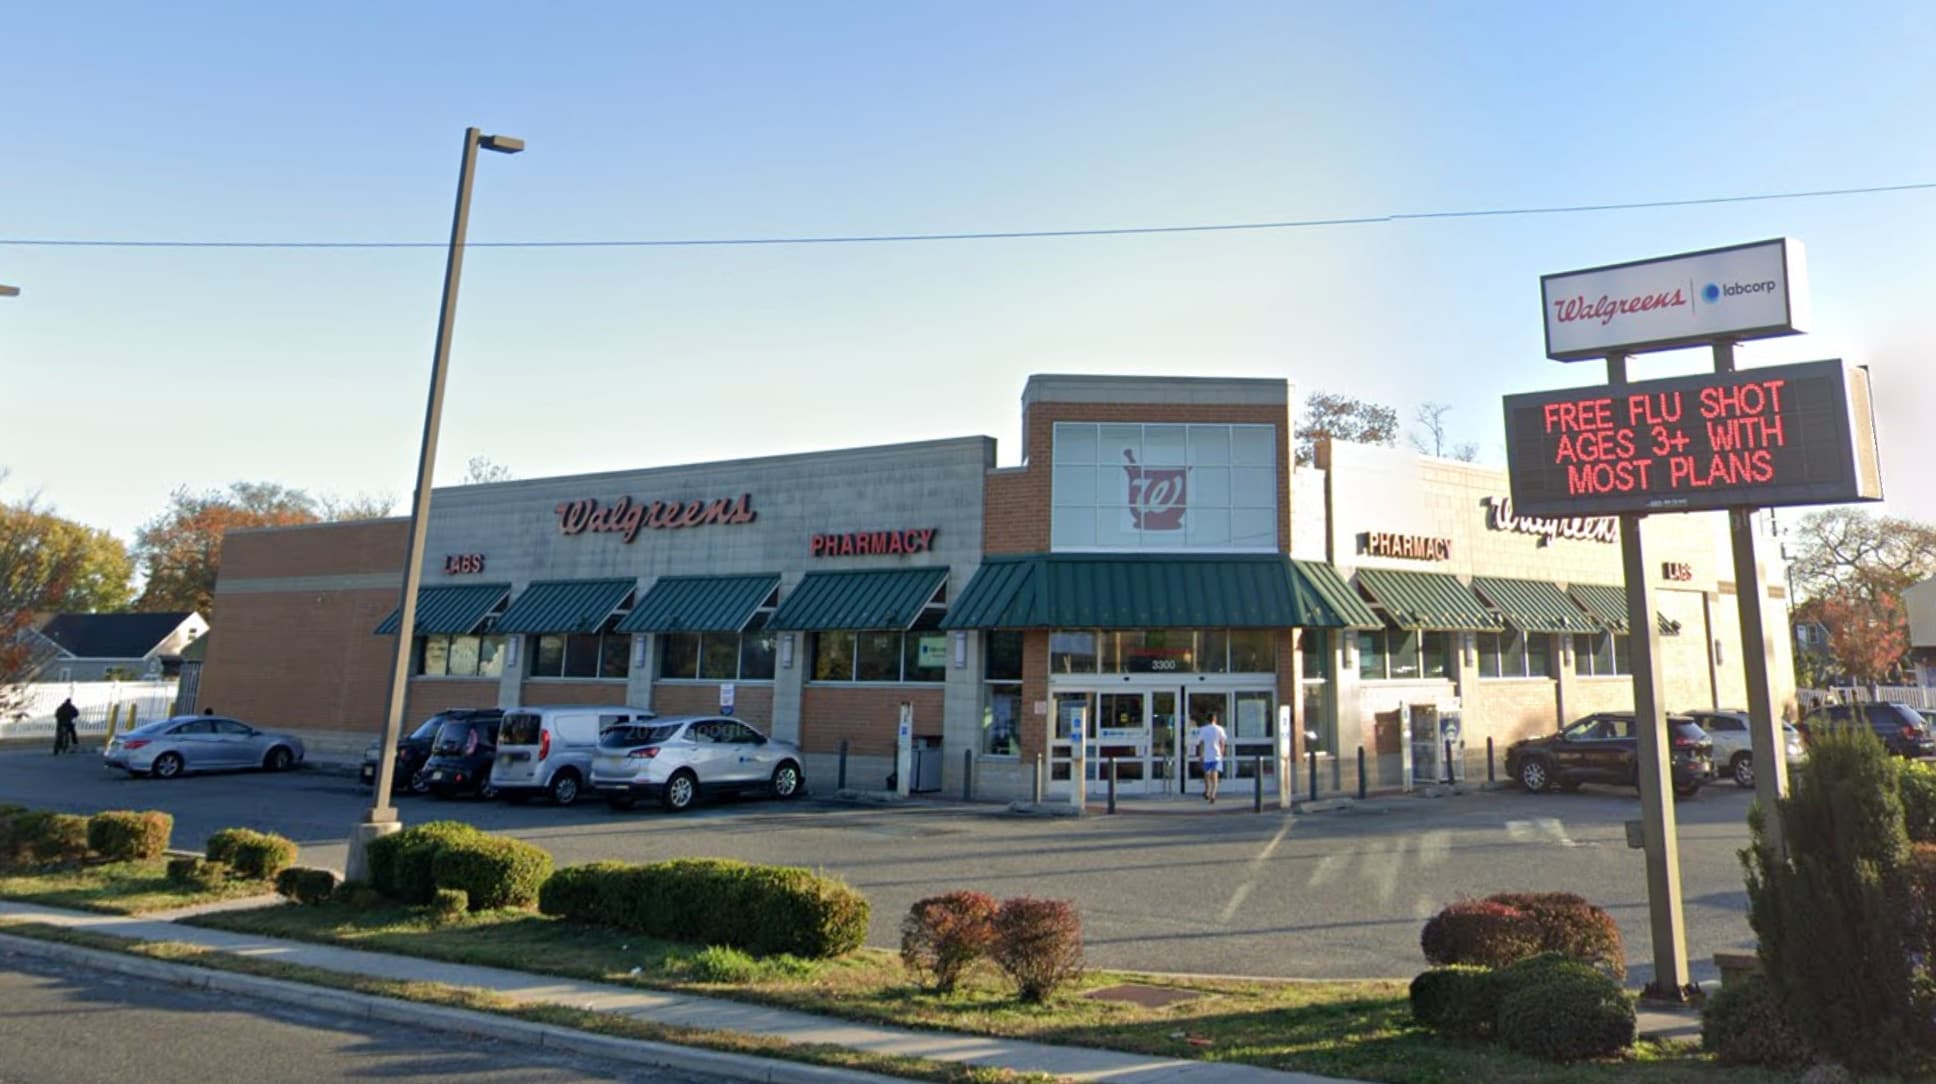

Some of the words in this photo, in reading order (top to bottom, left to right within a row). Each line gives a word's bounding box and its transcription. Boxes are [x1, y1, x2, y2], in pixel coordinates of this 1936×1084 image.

[1554, 289, 1686, 325] Walgreens
[1722, 278, 1776, 298] labcorp
[1544, 399, 1614, 433] FREE
[1629, 391, 1682, 427] FLU
[1700, 380, 1785, 419] SHOT
[1556, 429, 1635, 464] AGES
[1651, 425, 1690, 457] 3+
[1707, 416, 1785, 451] WITH
[1568, 459, 1652, 495] MOST
[1670, 450, 1774, 487] PLANS
[555, 493, 758, 545] Walgreens
[442, 553, 485, 575] LABS
[809, 527, 939, 557] PHARMACY
[1357, 532, 1452, 561] PHARMACY
[1152, 659, 1176, 671] 3300
